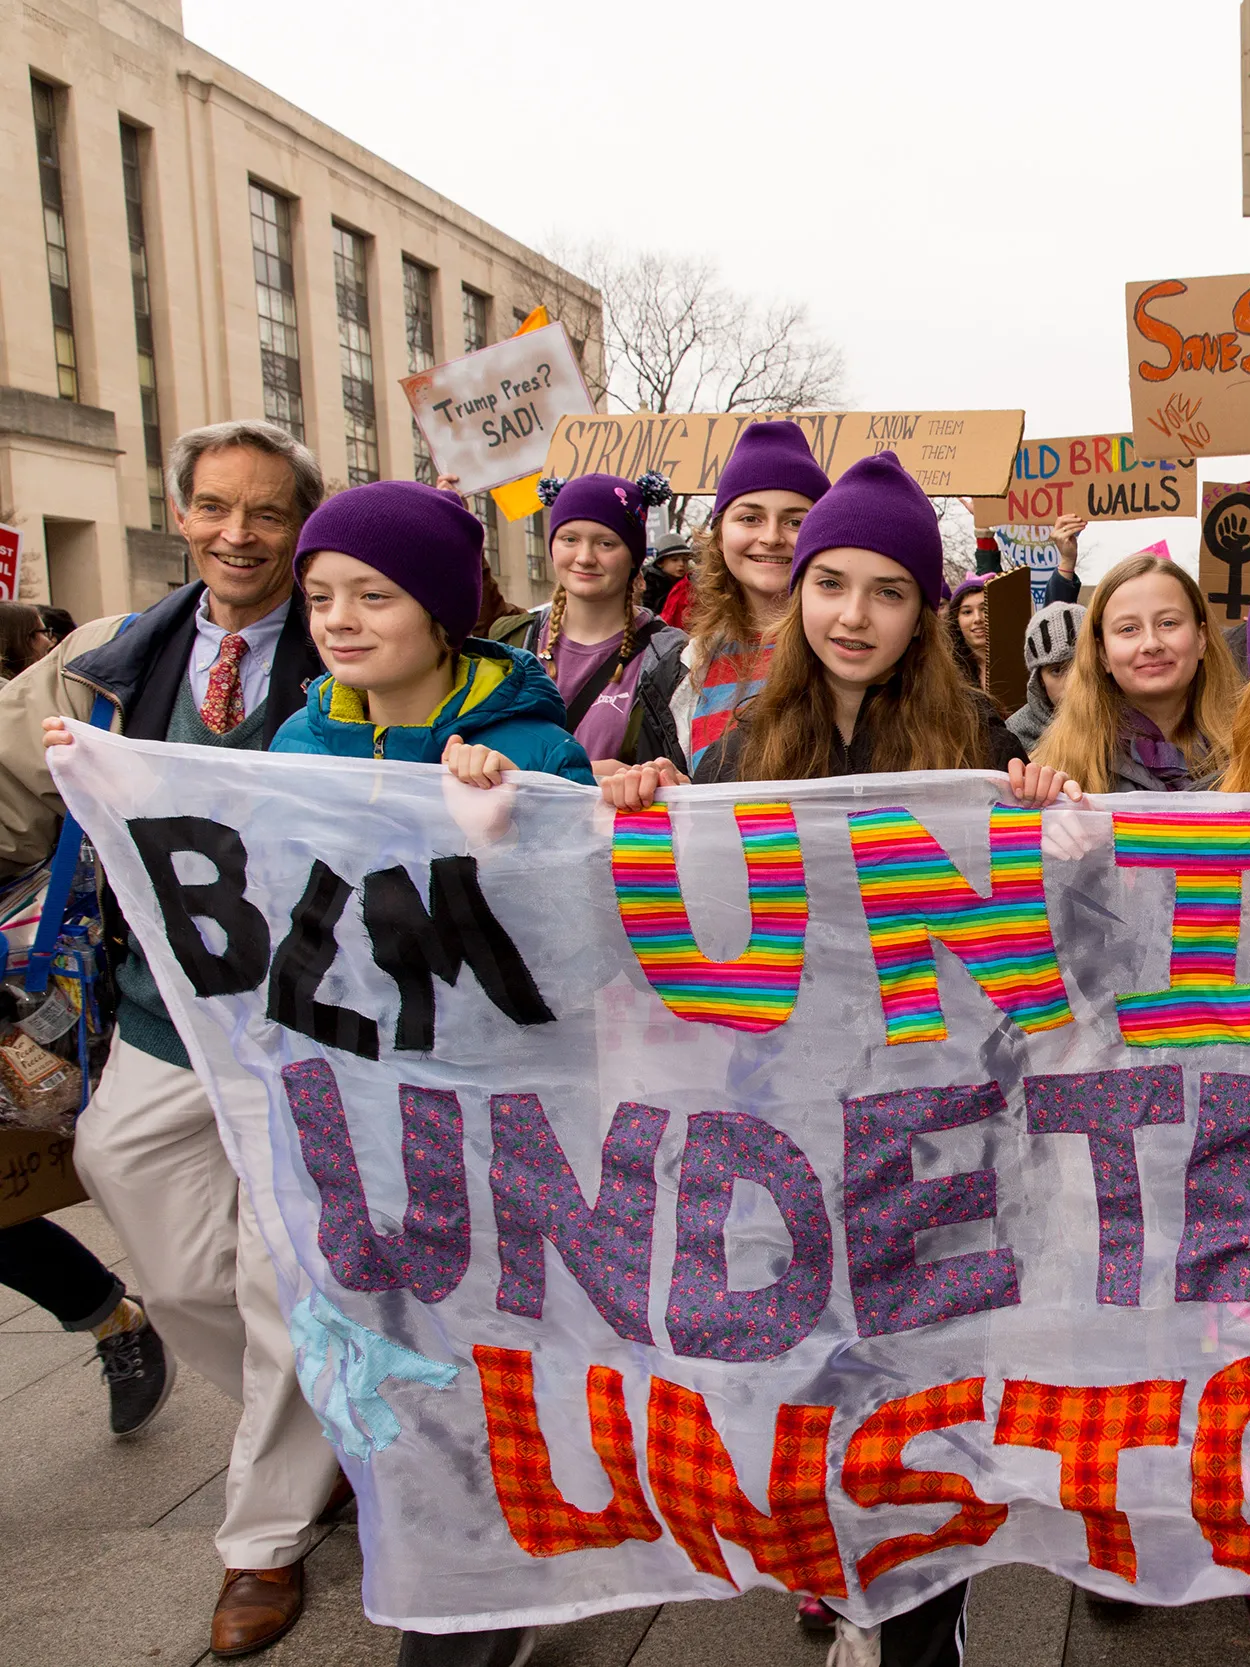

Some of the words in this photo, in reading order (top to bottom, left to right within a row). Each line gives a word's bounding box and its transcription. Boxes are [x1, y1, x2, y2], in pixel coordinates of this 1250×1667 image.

[433, 394, 498, 423] Trump
[500, 363, 552, 400] Pres?
[1147, 393, 1203, 437] VOTE
[481, 401, 544, 448] SAD!
[866, 415, 923, 440] KNOW
[927, 420, 965, 436] THEM
[1177, 421, 1211, 456] NO
[550, 418, 689, 481] STRONG
[922, 445, 957, 460] THEM
[1014, 444, 1061, 480] ILD
[916, 470, 951, 486] THEM
[1008, 481, 1074, 521] NOT
[1088, 476, 1181, 516] WALLS
[126, 814, 556, 1061] BLM
